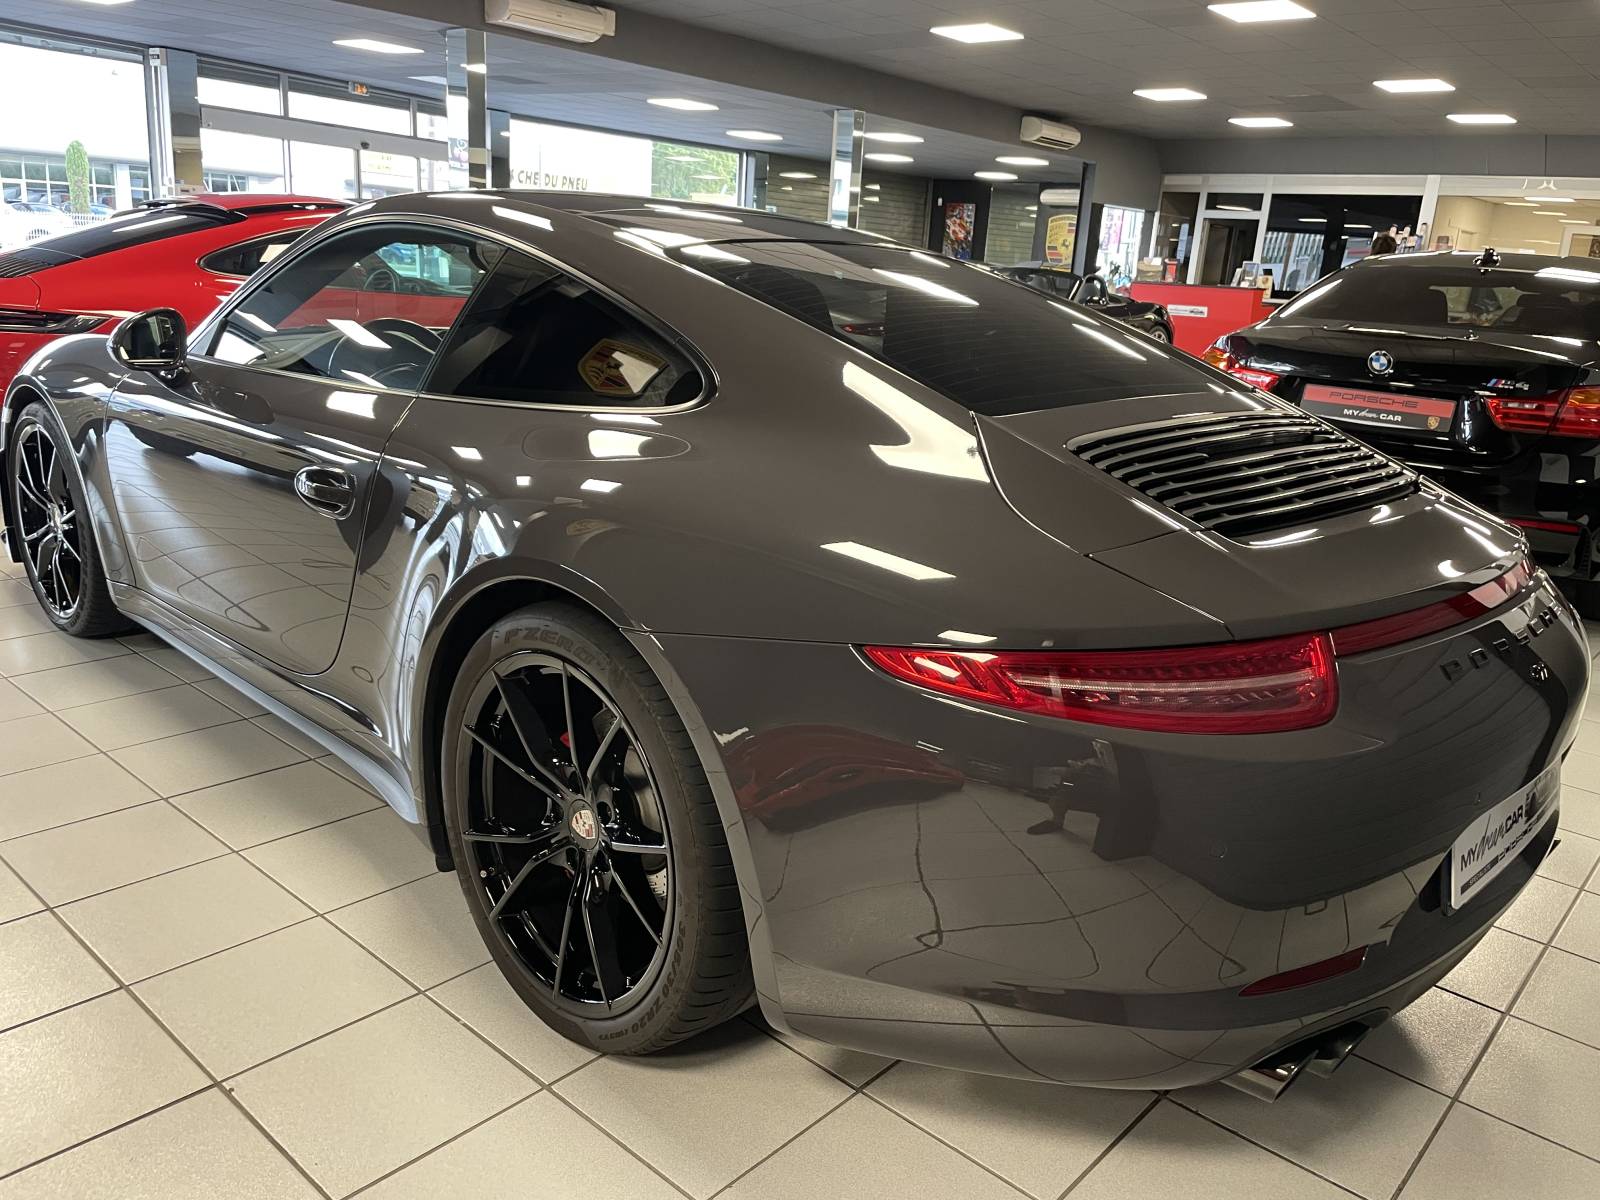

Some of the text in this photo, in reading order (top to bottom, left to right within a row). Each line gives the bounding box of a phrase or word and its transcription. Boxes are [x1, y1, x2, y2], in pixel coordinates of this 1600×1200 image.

[544, 173, 558, 188] DU
[562, 175, 588, 191] PNEU
[1328, 391, 1419, 409] PORSCHE
[1343, 408, 1360, 418] MY
[1379, 413, 1402, 423] CAR
[1460, 842, 1478, 872] MY
[1504, 804, 1524, 834] CAR
